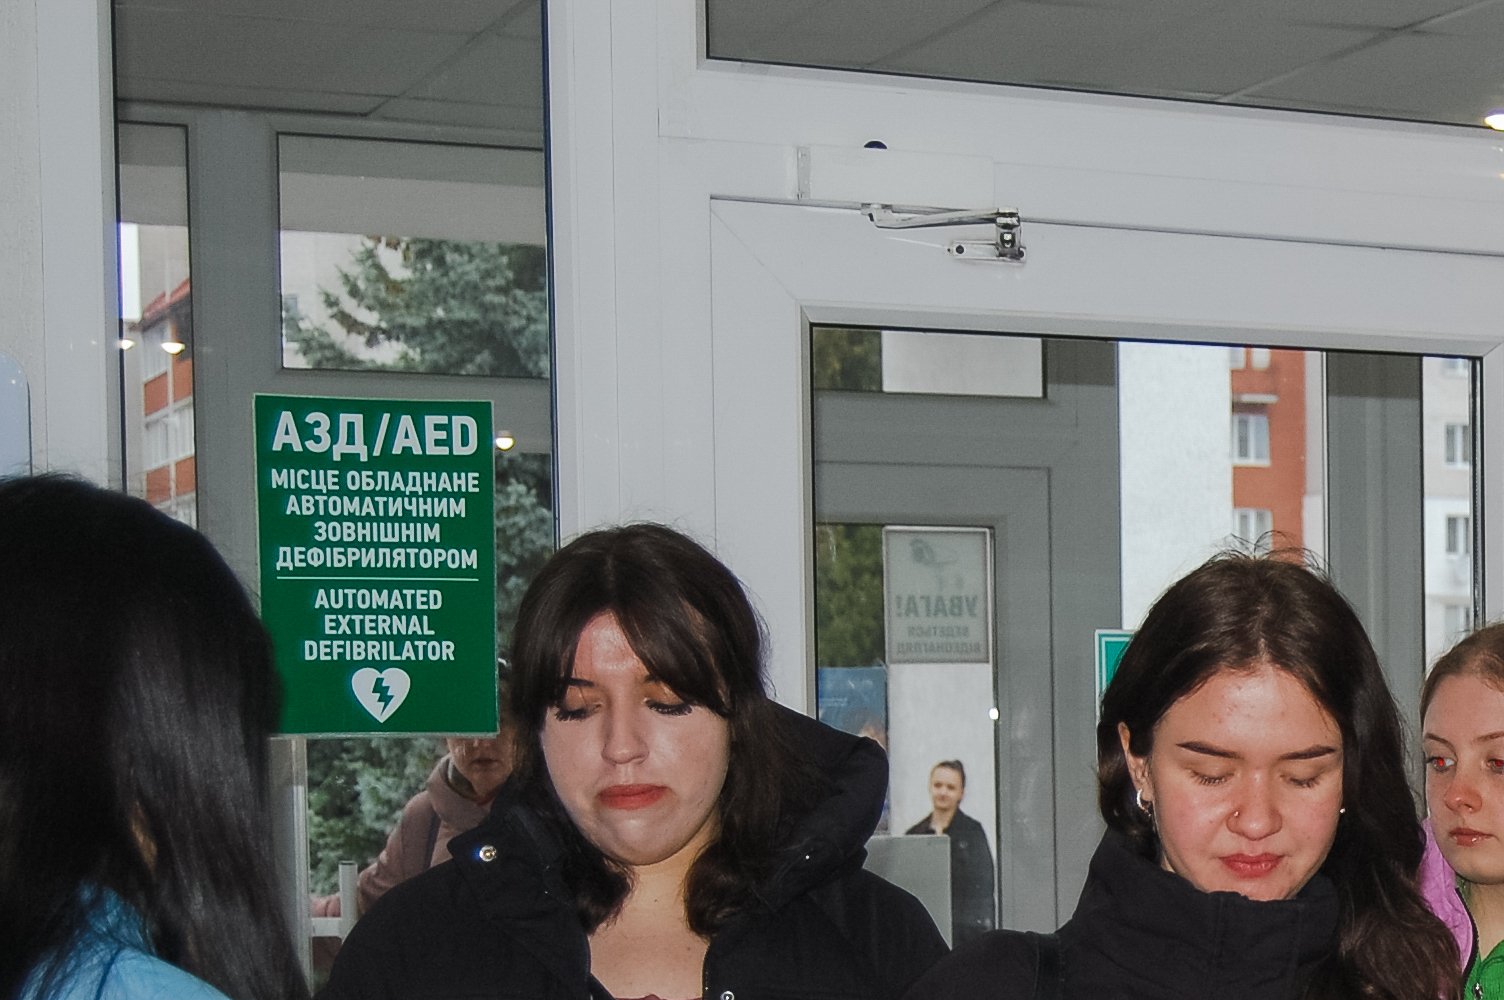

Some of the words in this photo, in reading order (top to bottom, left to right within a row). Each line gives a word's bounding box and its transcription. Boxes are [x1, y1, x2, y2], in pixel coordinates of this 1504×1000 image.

[271, 410, 479, 462] АЗД/AED
[271, 468, 340, 494] МІСЦЕ
[346, 470, 480, 496] ОБЛАДНАНЕ
[285, 495, 467, 519] АВТОМАТИЧНИМ
[313, 521, 441, 543] ЗОВНІШНІМ
[276, 546, 479, 571] ДЕФІБРИЛЯТОРОМ
[314, 588, 443, 610] AUTOMATED
[324, 614, 436, 636] EXTERNAL
[304, 639, 456, 661] DEFIBRILATOR
